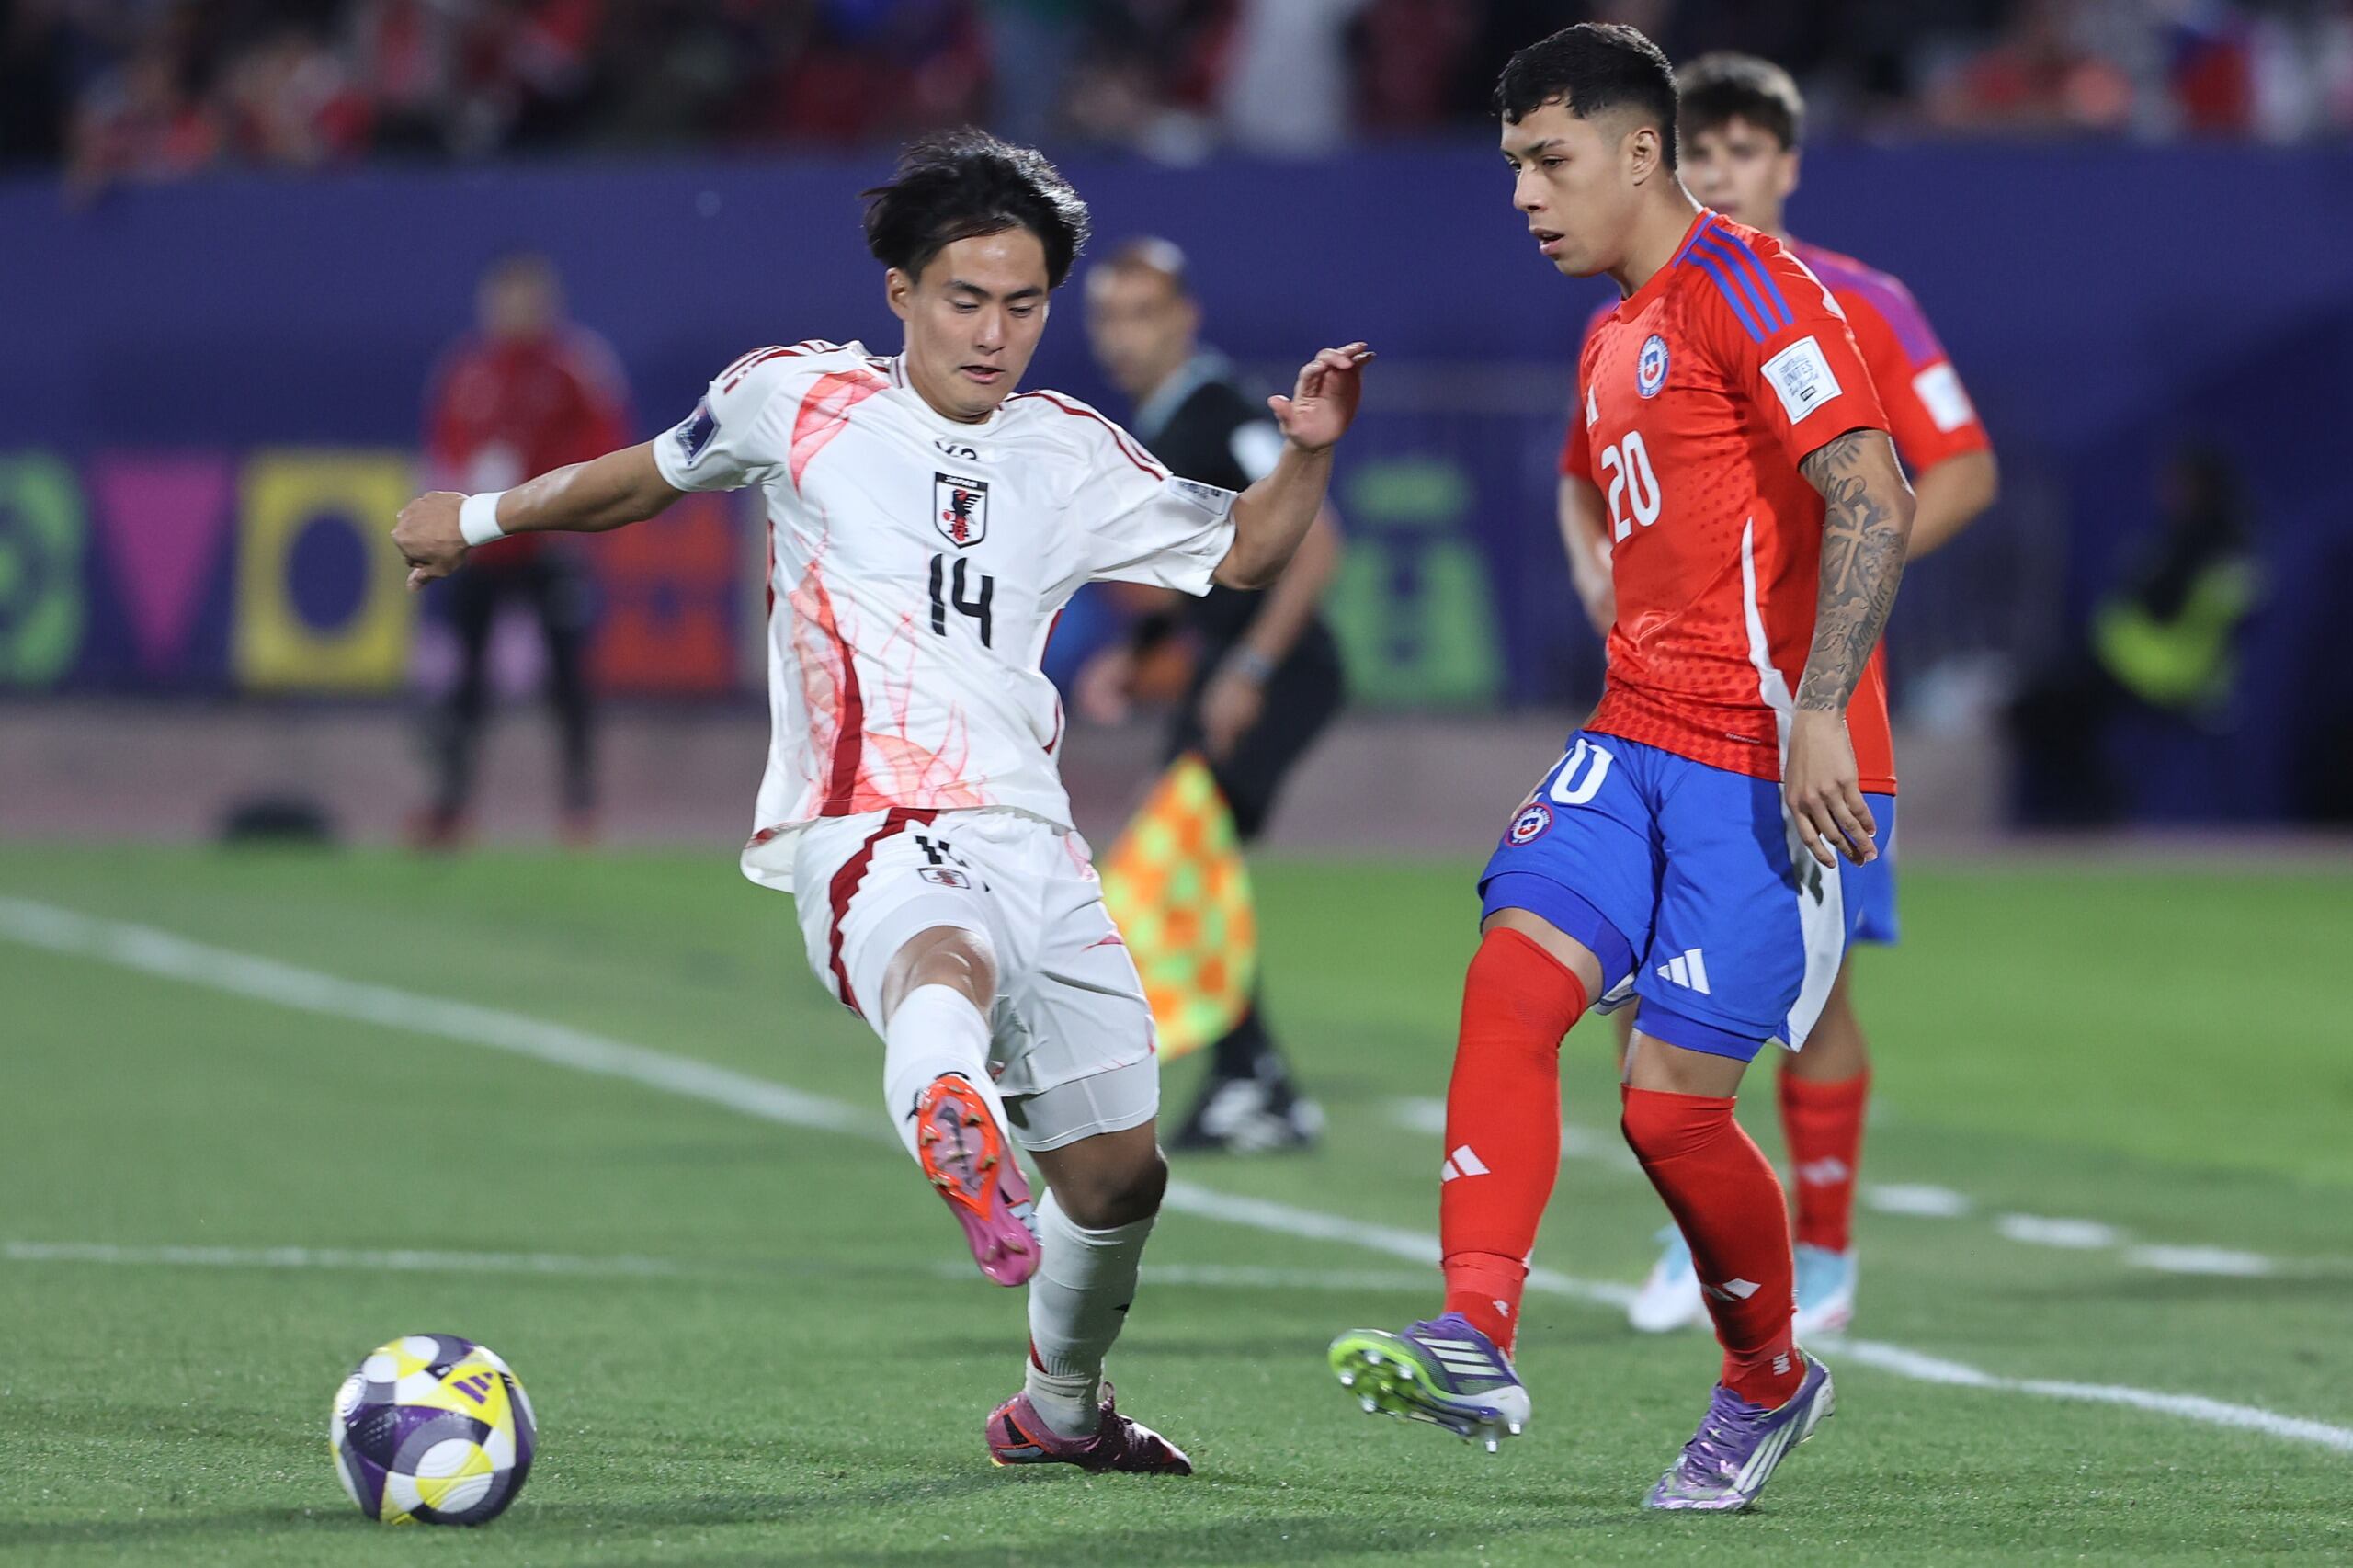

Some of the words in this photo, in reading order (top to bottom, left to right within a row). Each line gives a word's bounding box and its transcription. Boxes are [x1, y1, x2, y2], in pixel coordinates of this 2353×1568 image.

[1601, 430, 1661, 543] 20
[929, 553, 994, 650] 14
[1530, 738, 1614, 805] 0
